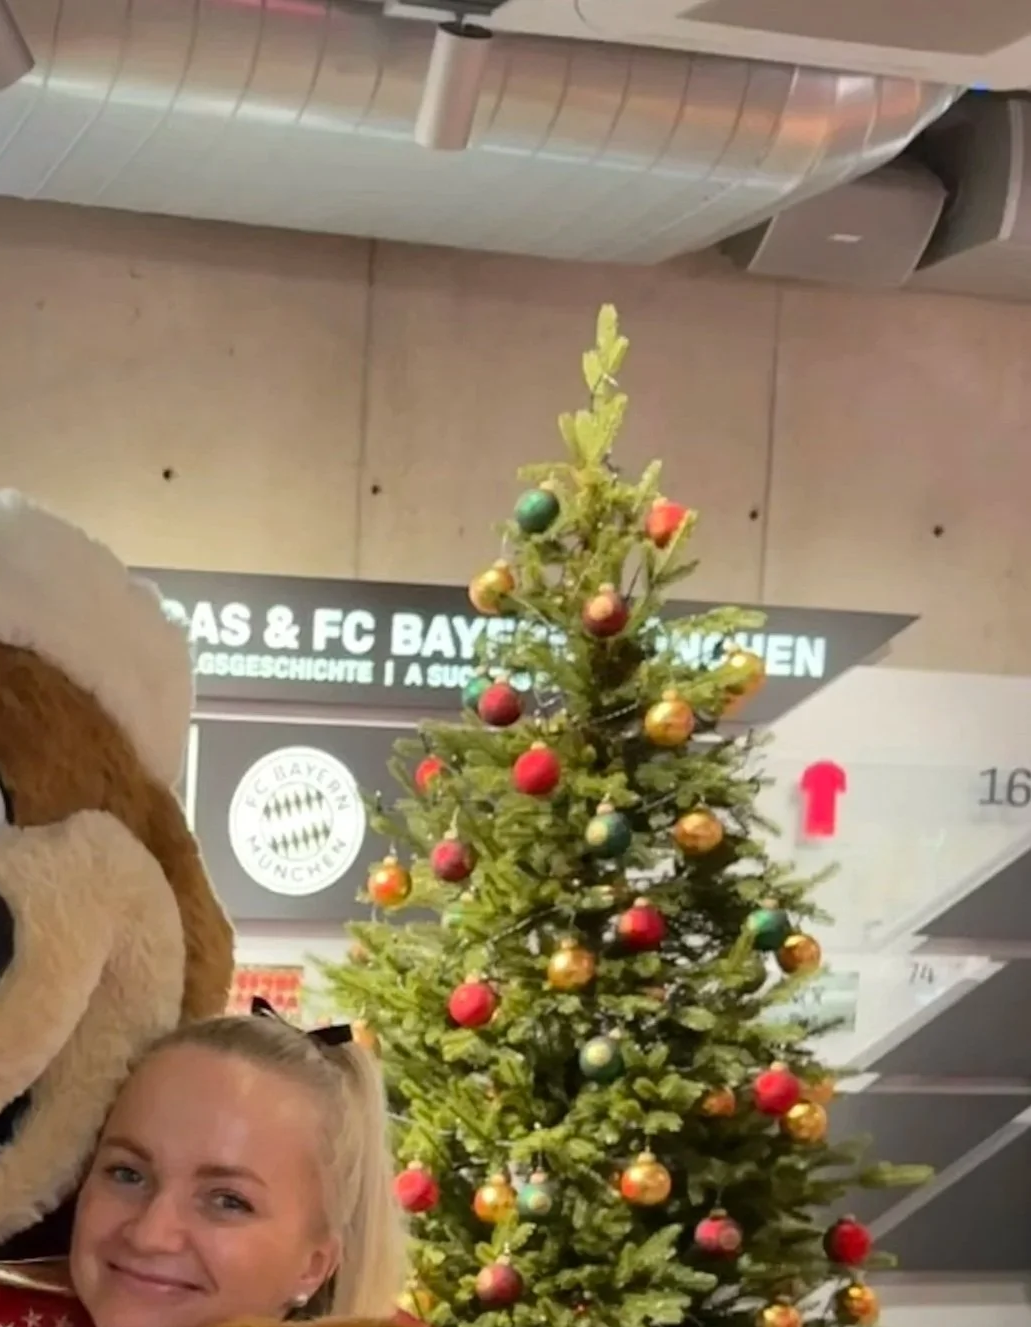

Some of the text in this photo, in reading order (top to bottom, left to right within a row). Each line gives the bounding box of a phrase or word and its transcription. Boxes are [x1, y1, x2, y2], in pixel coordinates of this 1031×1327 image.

[263, 604, 300, 649] &
[313, 609, 375, 654] FC
[192, 651, 373, 686] GSGESCHICHTE
[404, 663, 422, 687] A
[245, 762, 350, 811] FC BAYERN
